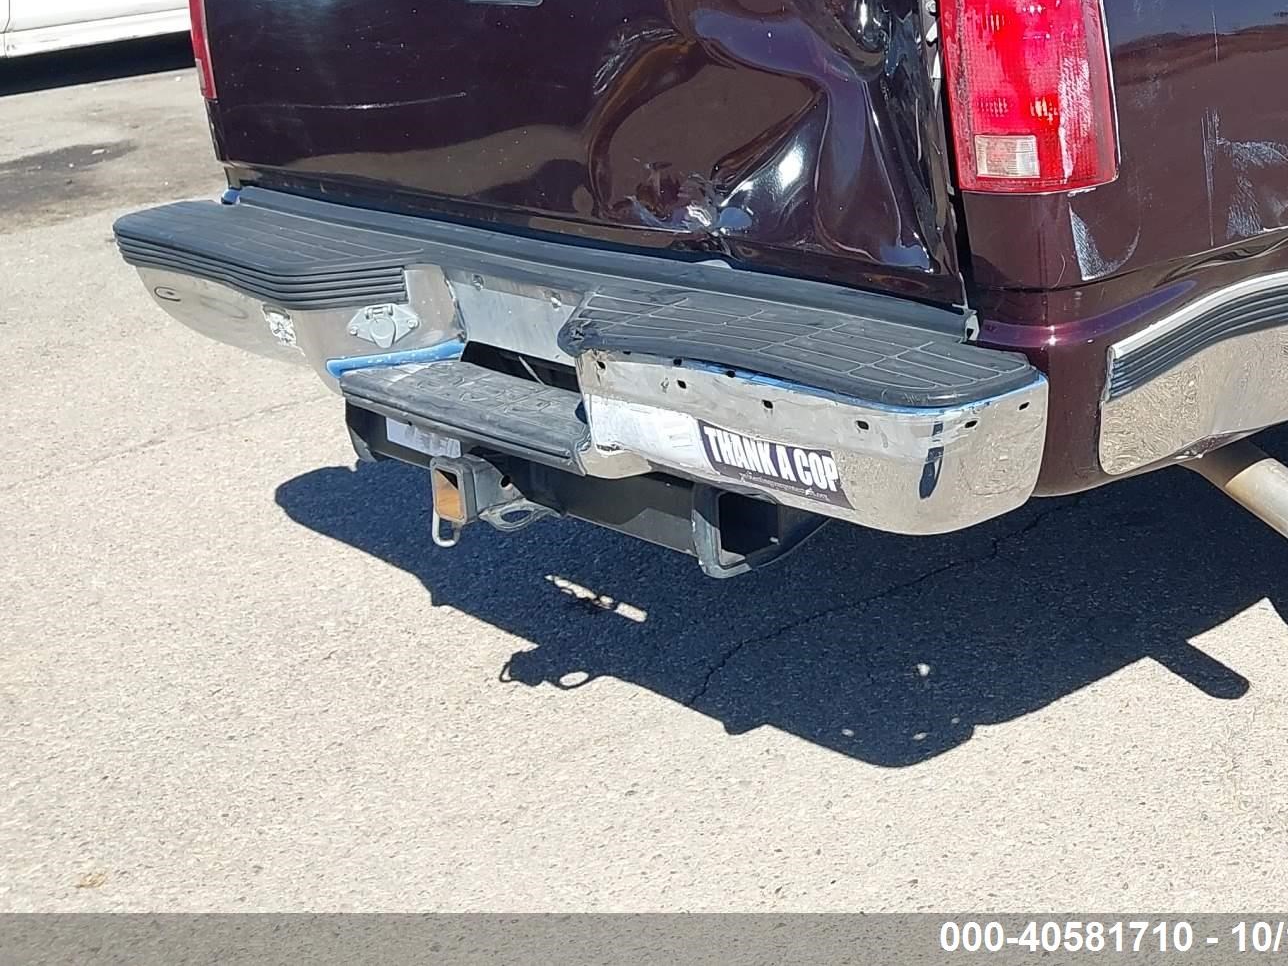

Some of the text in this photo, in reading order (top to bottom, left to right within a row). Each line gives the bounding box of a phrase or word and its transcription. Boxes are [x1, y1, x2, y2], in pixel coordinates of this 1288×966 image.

[703, 425, 779, 477] THANK
[776, 444, 797, 482] A
[793, 448, 839, 492] COP
